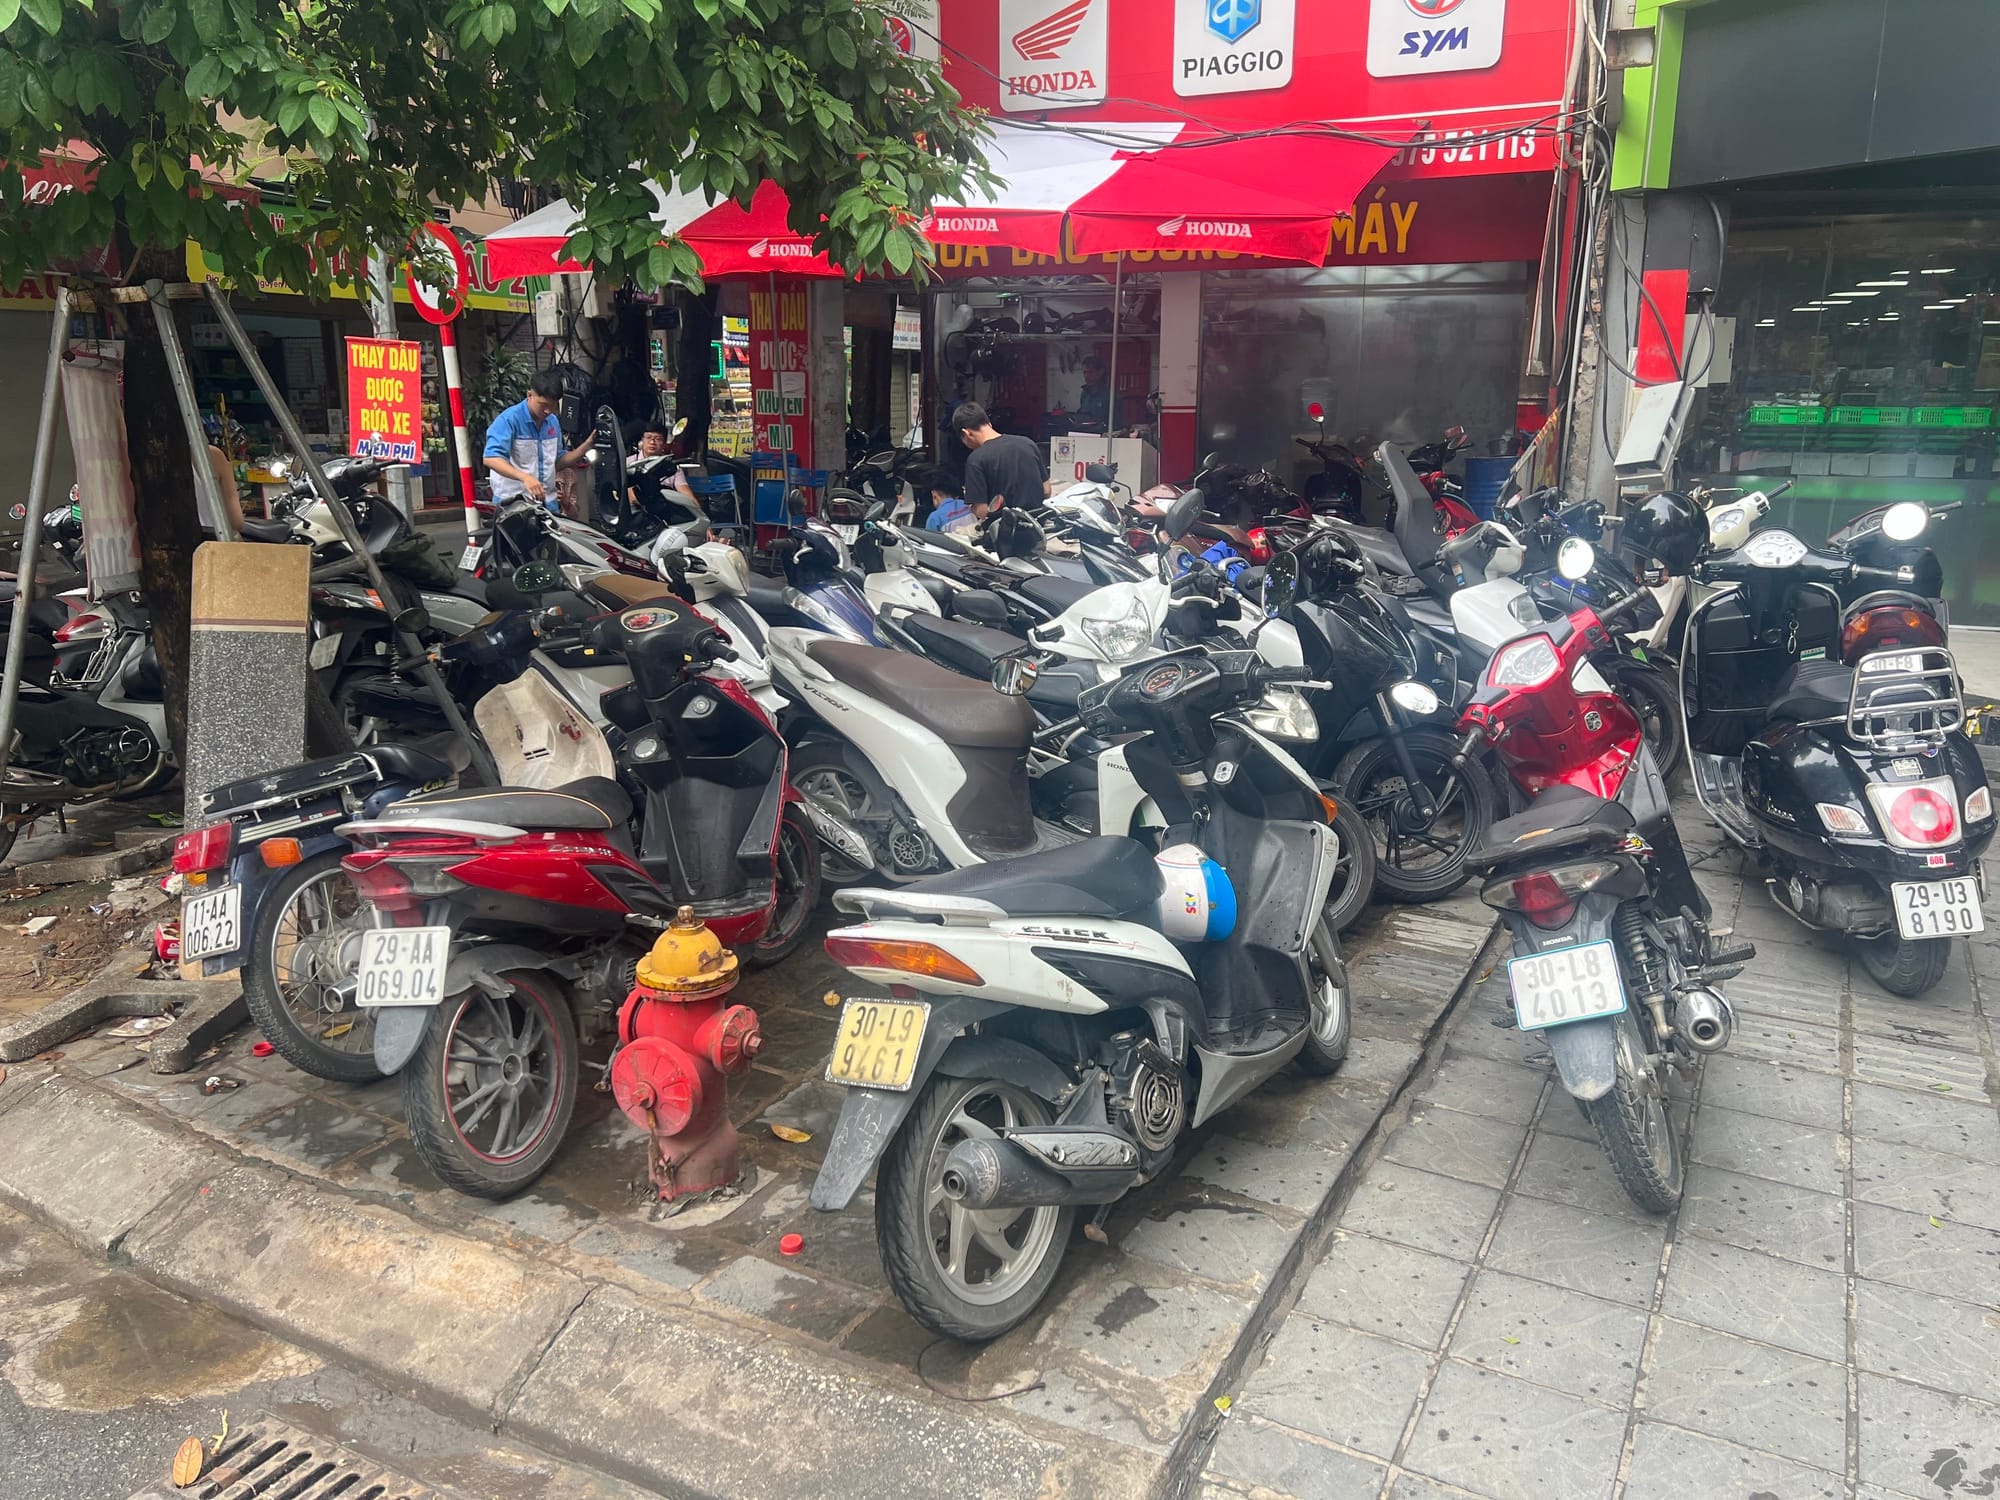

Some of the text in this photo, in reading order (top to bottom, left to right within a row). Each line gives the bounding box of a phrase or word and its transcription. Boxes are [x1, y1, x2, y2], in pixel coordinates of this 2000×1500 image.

[1399, 27, 1469, 57] SYM
[1182, 50, 1283, 78] PIAGGIO
[1008, 69, 1096, 95] HONDA
[937, 217, 999, 232] HONDA
[1185, 221, 1252, 238] HONDA
[1327, 186, 1418, 255] MÁY
[351, 342, 417, 372] THAY DẦU
[366, 377, 404, 407] ĐƯỢC
[361, 402, 411, 435] RỬA XE
[392, 440, 417, 460] PHÍ
[388, 807, 420, 815] KYMCO
[194, 893, 227, 928] 11-AA
[1905, 882, 1967, 909] 29-U3
[1021, 926, 1110, 940] CLICK
[1911, 908, 1973, 934] 8190
[188, 920, 233, 957] 006.22
[1542, 935, 1573, 947] HONDA
[364, 968, 436, 1000] 069.04
[1523, 949, 1600, 989] 30-L8
[1533, 981, 1608, 1021] 4013
[850, 1005, 914, 1042] 30-L9
